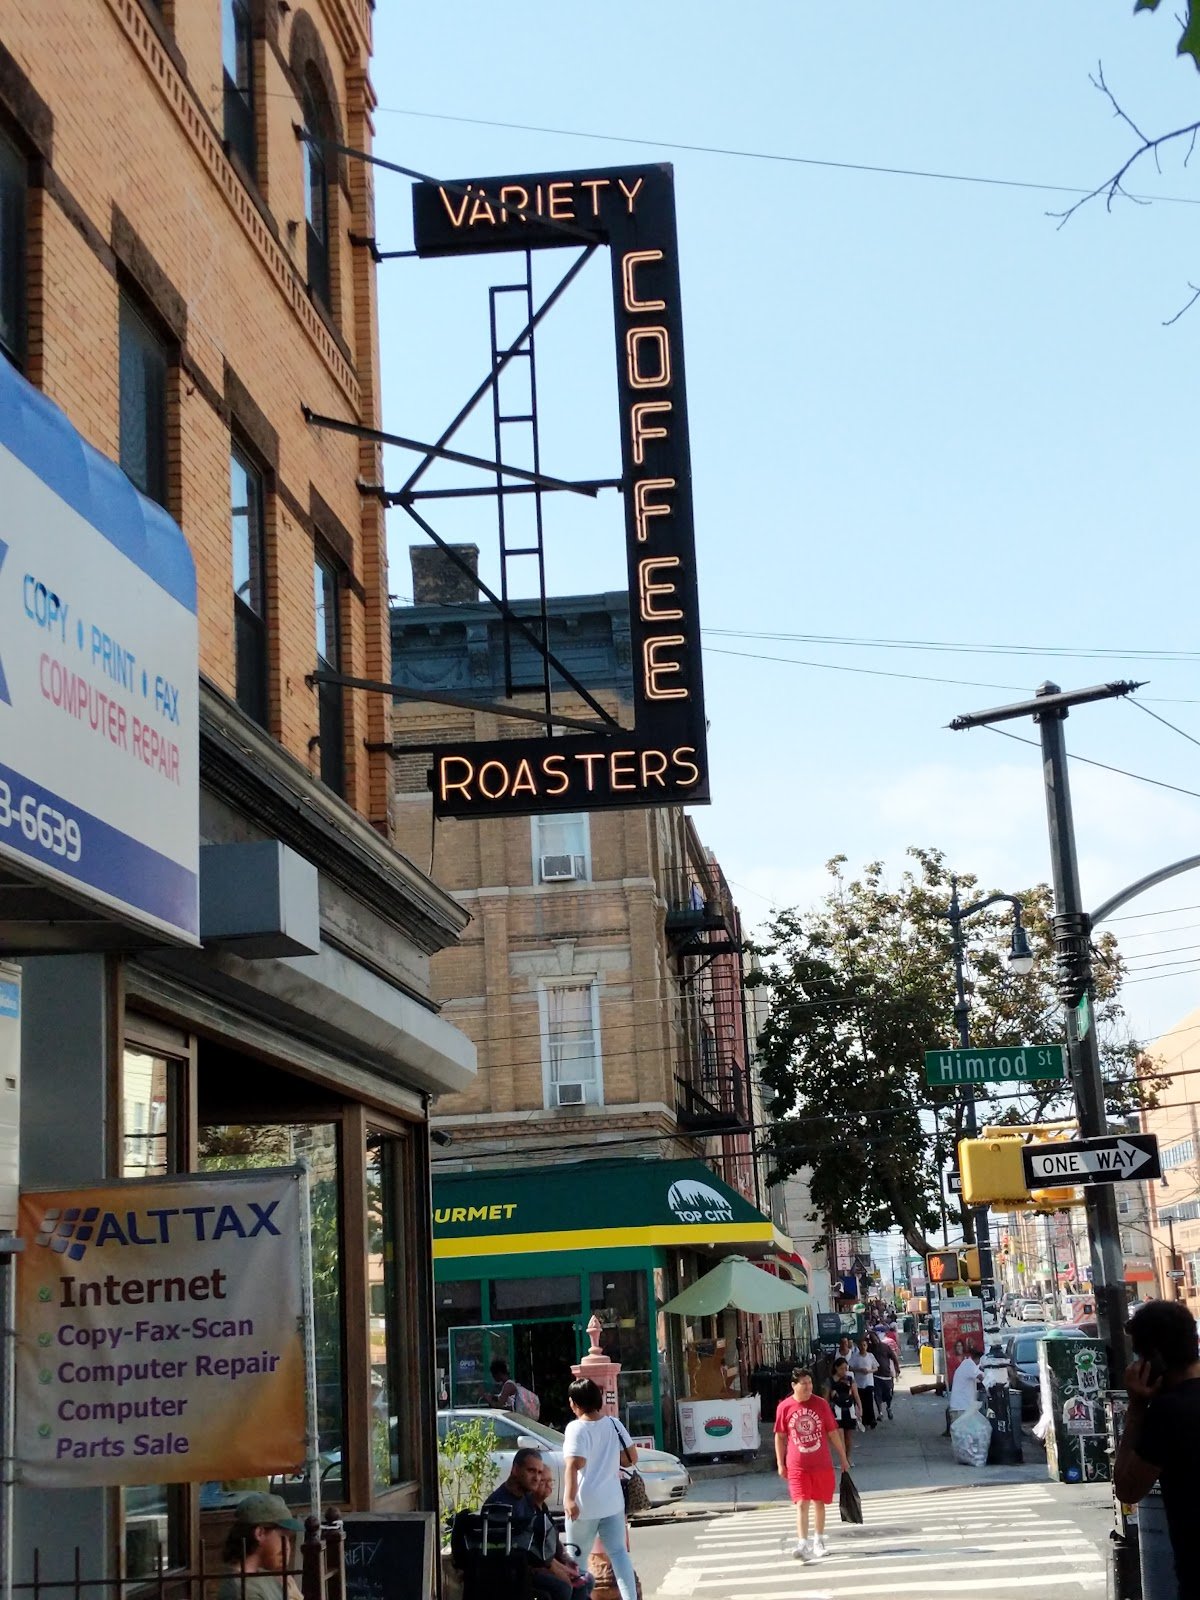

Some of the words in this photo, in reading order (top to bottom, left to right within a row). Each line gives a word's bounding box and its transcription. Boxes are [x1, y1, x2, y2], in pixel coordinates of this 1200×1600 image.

[439, 177, 643, 227] VARIETY
[622, 249, 689, 700] COFFEE
[23, 573, 69, 644] COPY
[91, 624, 135, 693] PRINT
[155, 676, 180, 726] FAX
[40, 653, 127, 750] COMPUTER
[132, 716, 180, 786] REPAIR
[440, 746, 699, 801] ROASTERS
[939, 1051, 1028, 1080] Himrod
[1038, 1050, 1052, 1066] St
[1043, 1155, 1080, 1174] ONE
[1096, 1149, 1136, 1169] WAY
[432, 1203, 518, 1223] URMET
[674, 1210, 703, 1222] TOP
[704, 1209, 734, 1221] CITY
[59, 1268, 227, 1308] Internet
[57, 1317, 254, 1350] Copy-Fax-Scan
[57, 1358, 188, 1386] Computer
[195, 1351, 281, 1380] Repair
[57, 1396, 188, 1424] Computer
[56, 1437, 125, 1459] Parts
[133, 1432, 189, 1456] Sale
